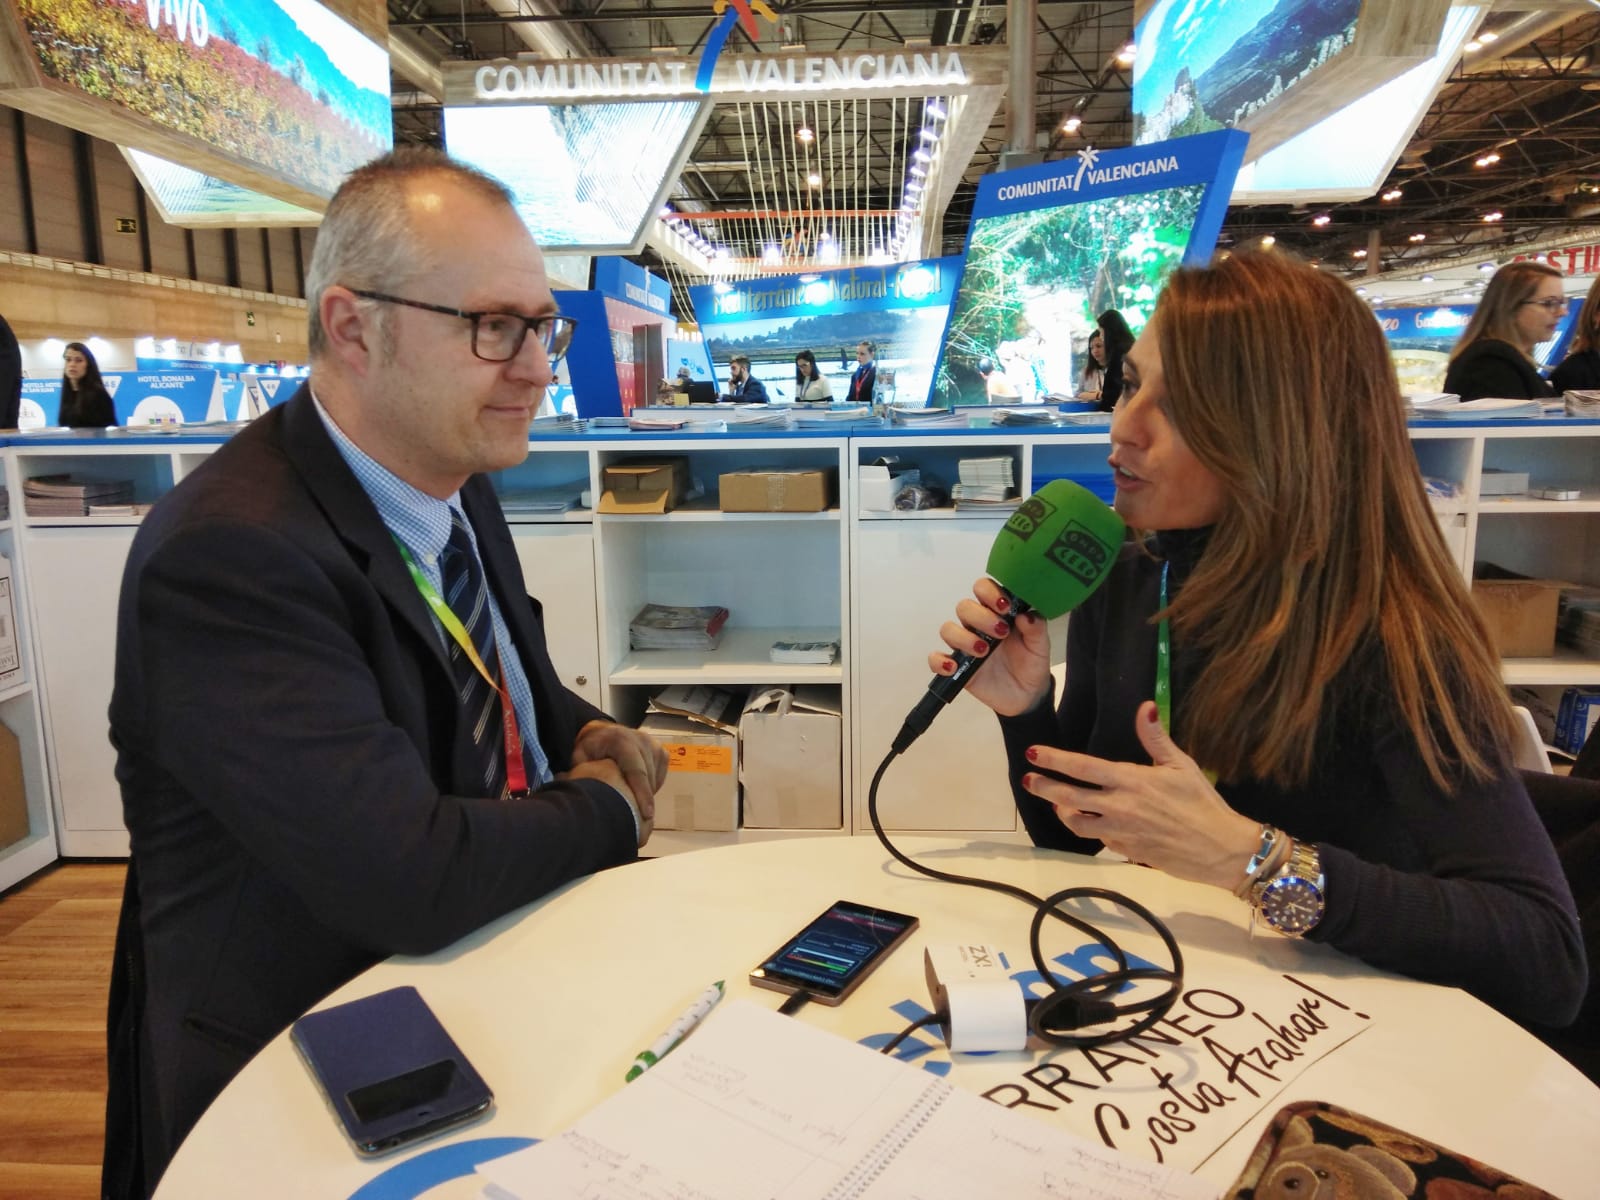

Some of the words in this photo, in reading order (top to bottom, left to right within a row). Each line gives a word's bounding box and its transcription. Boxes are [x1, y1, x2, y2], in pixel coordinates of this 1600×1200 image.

[475, 62, 686, 98] COMUNITAT
[736, 52, 967, 91] VALENCIANA
[998, 174, 1075, 201] COMUNITAT
[1087, 156, 1179, 185] VALENCIANA
[137, 375, 161, 383] HOTEL
[1060, 548, 1096, 577] CERO
[1094, 1066, 1237, 1164] Costa
